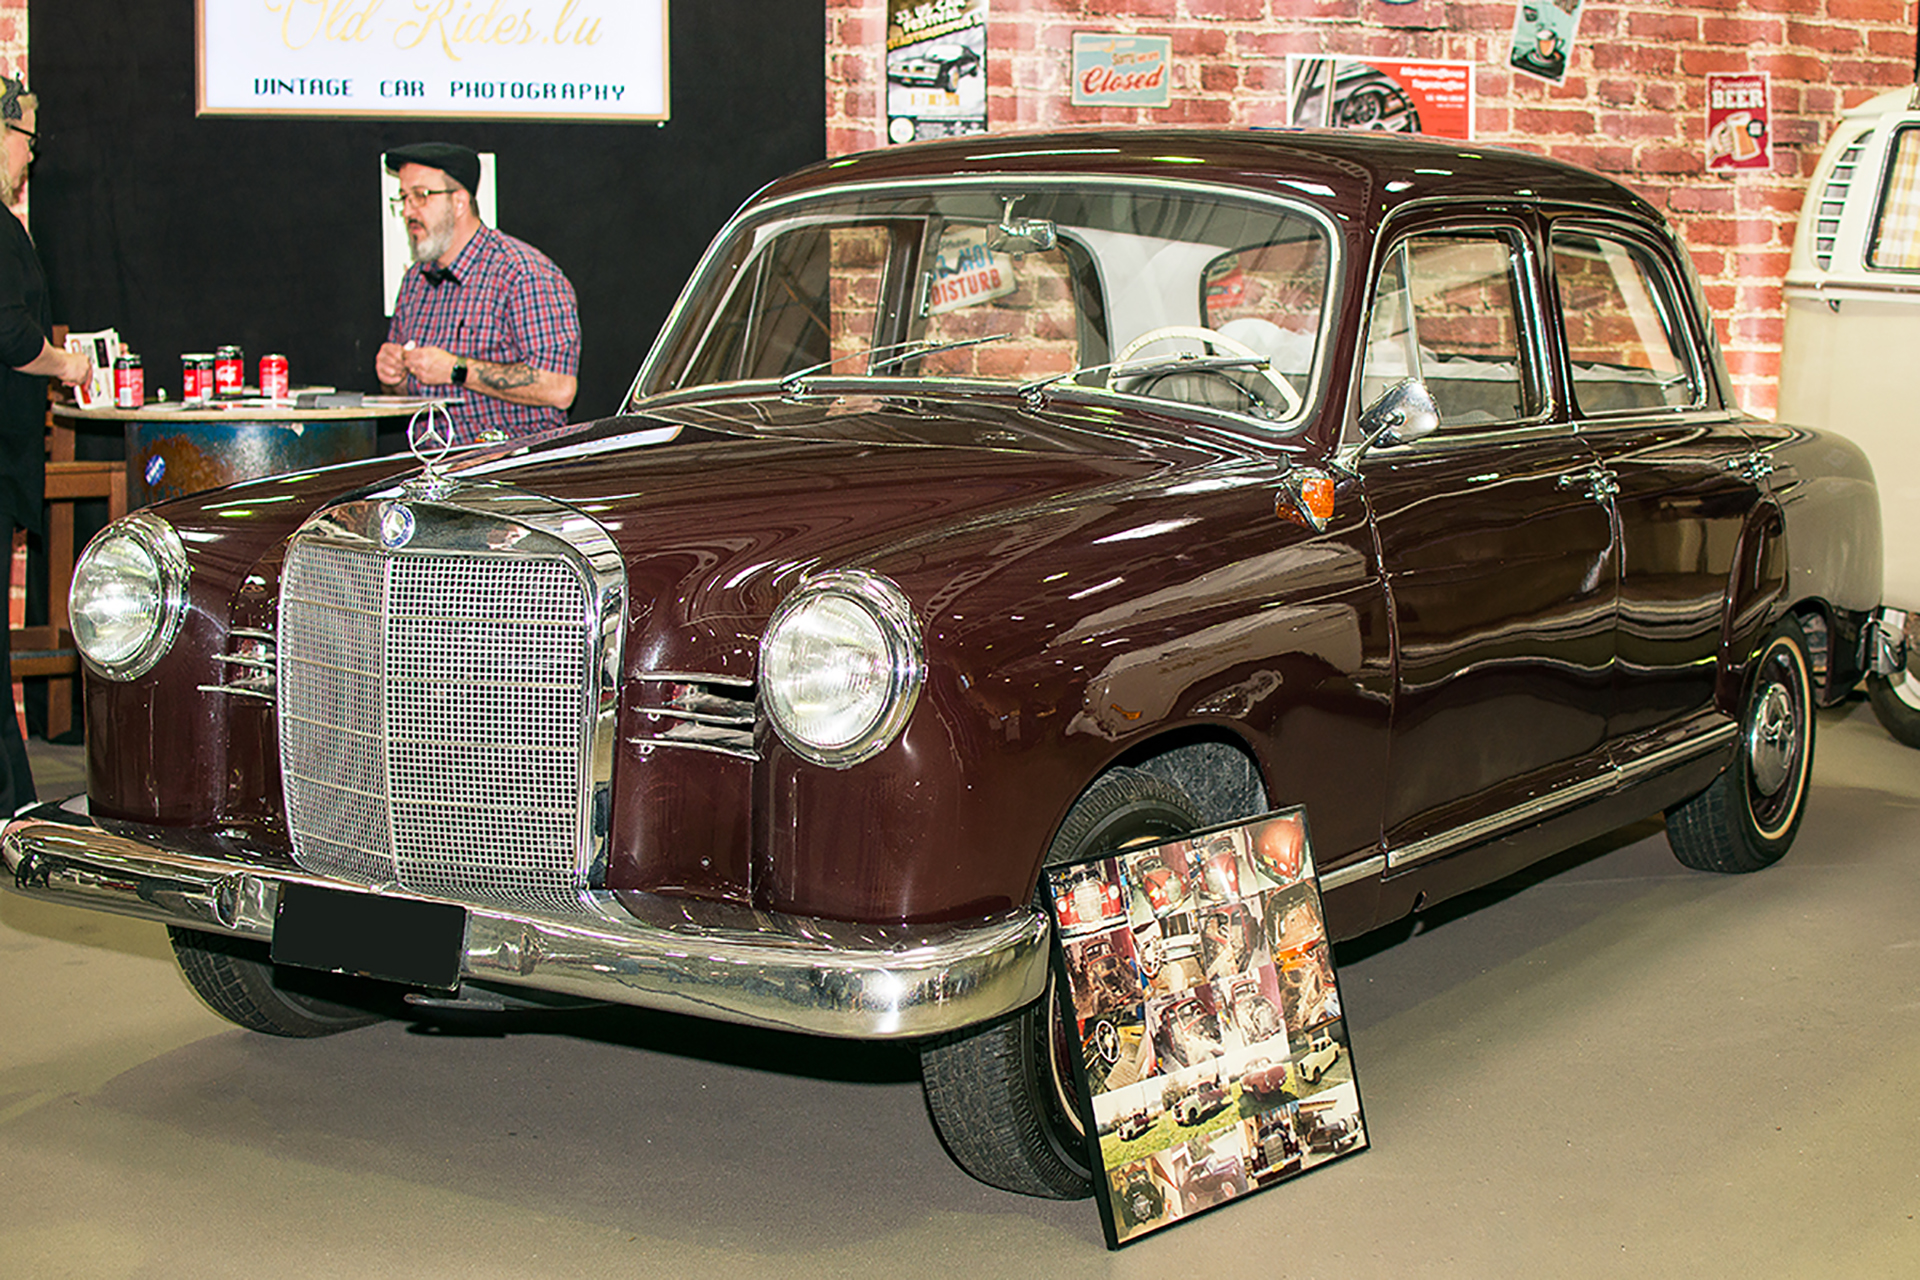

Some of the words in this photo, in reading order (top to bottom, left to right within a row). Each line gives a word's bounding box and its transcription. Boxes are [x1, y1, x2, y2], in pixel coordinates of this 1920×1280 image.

[253, 78, 353, 97] VINTAGE
[380, 80, 425, 98] CAR
[450, 81, 626, 101] PHOTOGRAPHY
[1078, 63, 1166, 95] Closed
[1711, 89, 1765, 109] BEER
[931, 268, 1002, 306] DISTURB
